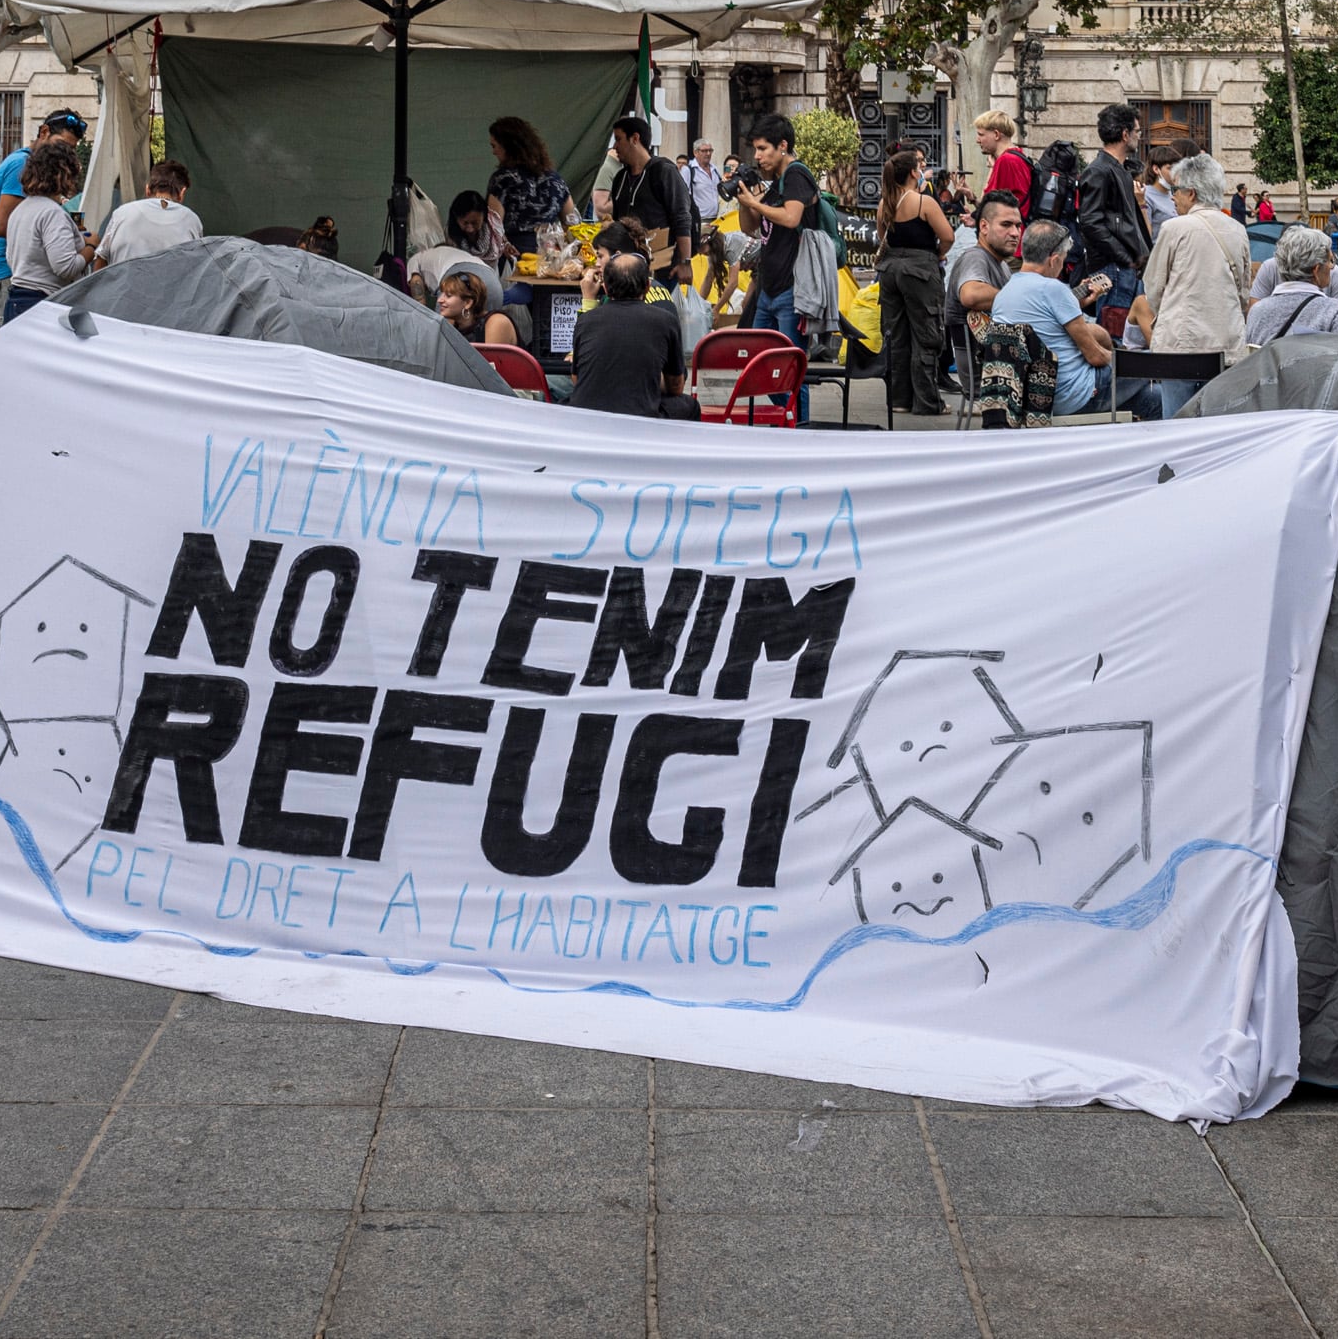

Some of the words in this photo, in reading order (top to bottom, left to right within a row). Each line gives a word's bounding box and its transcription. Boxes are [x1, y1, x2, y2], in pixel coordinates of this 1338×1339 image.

[202, 428, 487, 552] VALÈNCIA
[551, 478, 864, 571] S'OFEGA
[145, 532, 361, 677] NO
[406, 548, 856, 700] TENIM
[100, 672, 811, 888] REFUGI
[86, 841, 181, 916] PEL
[217, 857, 355, 928] DRET
[380, 870, 421, 934] A
[450, 880, 780, 968] L'HABITATGE
